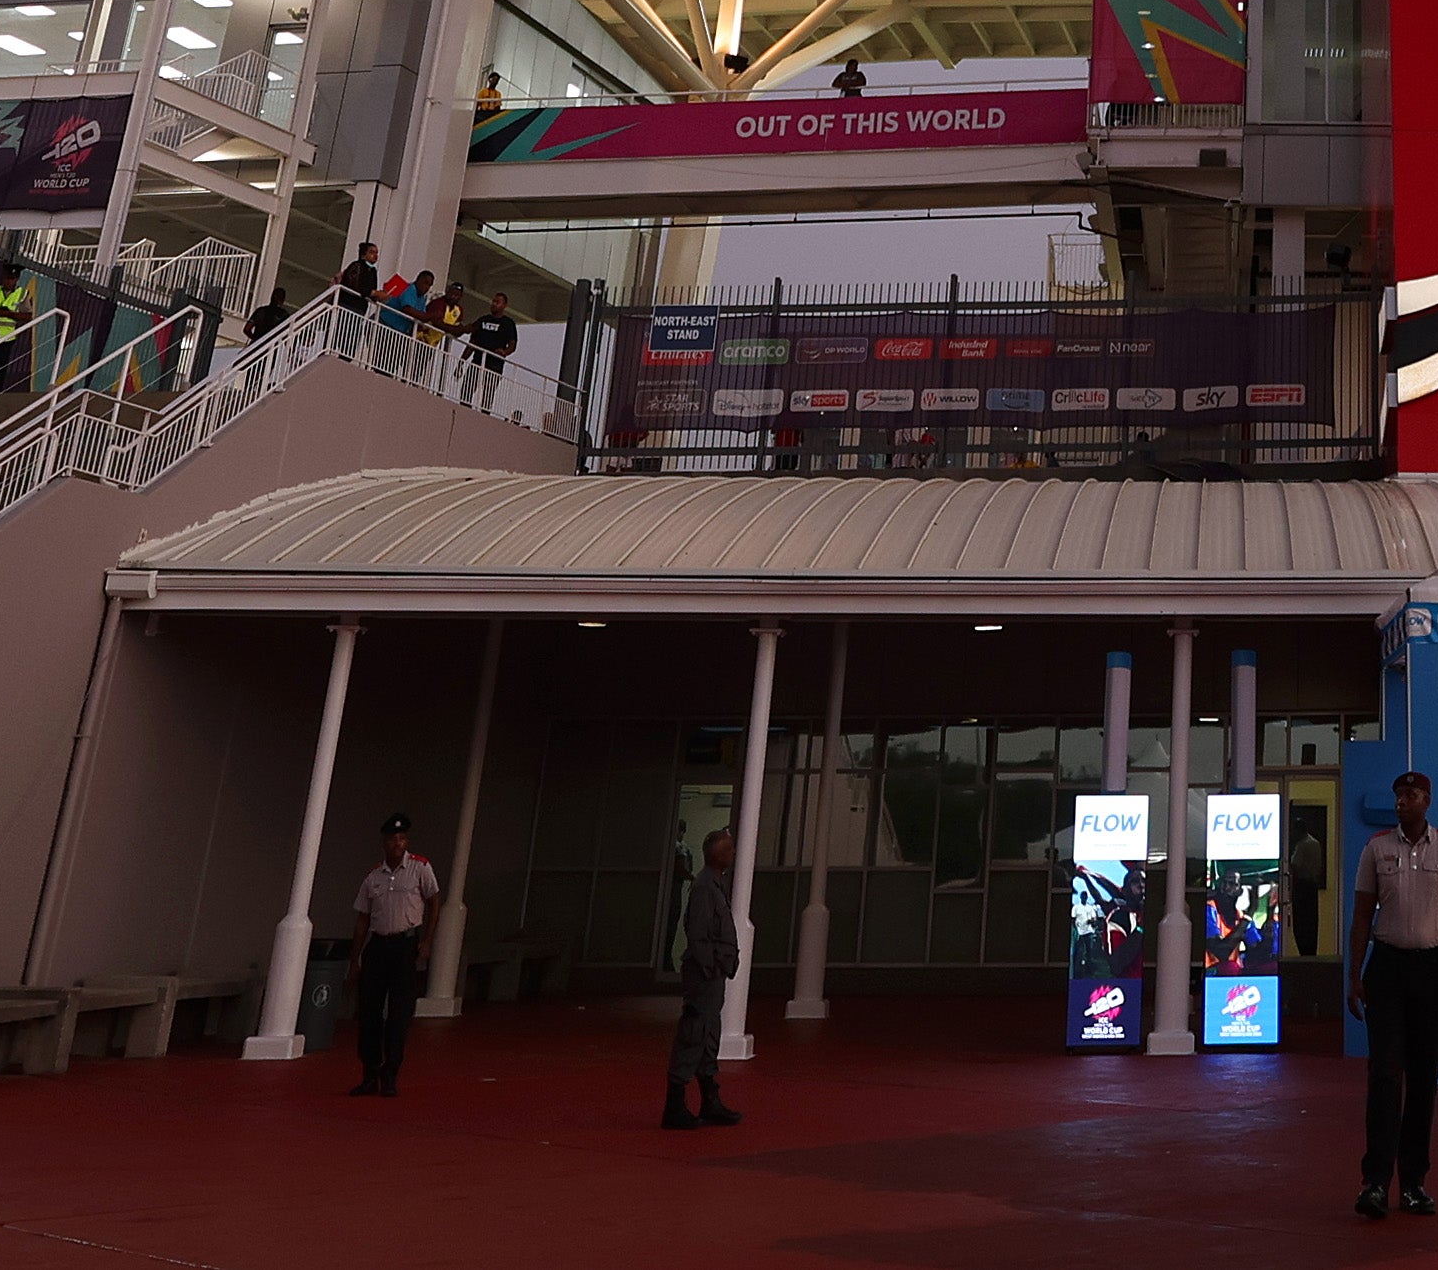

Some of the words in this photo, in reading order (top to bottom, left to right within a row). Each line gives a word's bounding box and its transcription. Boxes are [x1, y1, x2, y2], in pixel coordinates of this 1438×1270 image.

[736, 115, 791, 138] OUT
[797, 114, 835, 136] OF
[842, 111, 899, 135] THIS
[906, 107, 1006, 132] WORLD
[42, 120, 101, 161] T20
[57, 163, 71, 172] ICC
[33, 179, 67, 188] WORLD
[68, 178, 90, 187] CUP
[654, 316, 716, 327] NORTH-EAST
[666, 330, 699, 340] STAND
[948, 340, 988, 349] IndusInd
[723, 344, 785, 359] aramco
[841, 346, 865, 355] WORLD
[961, 349, 986, 357] Bank
[665, 394, 688, 402] STAR
[792, 395, 809, 407] sky
[812, 396, 845, 407] sports
[1196, 387, 1226, 407] sky
[1250, 387, 1302, 404] ESPN
[662, 401, 699, 412] SPORTS
[1080, 814, 1141, 833] FLOW
[1212, 813, 1273, 833] FLOW
